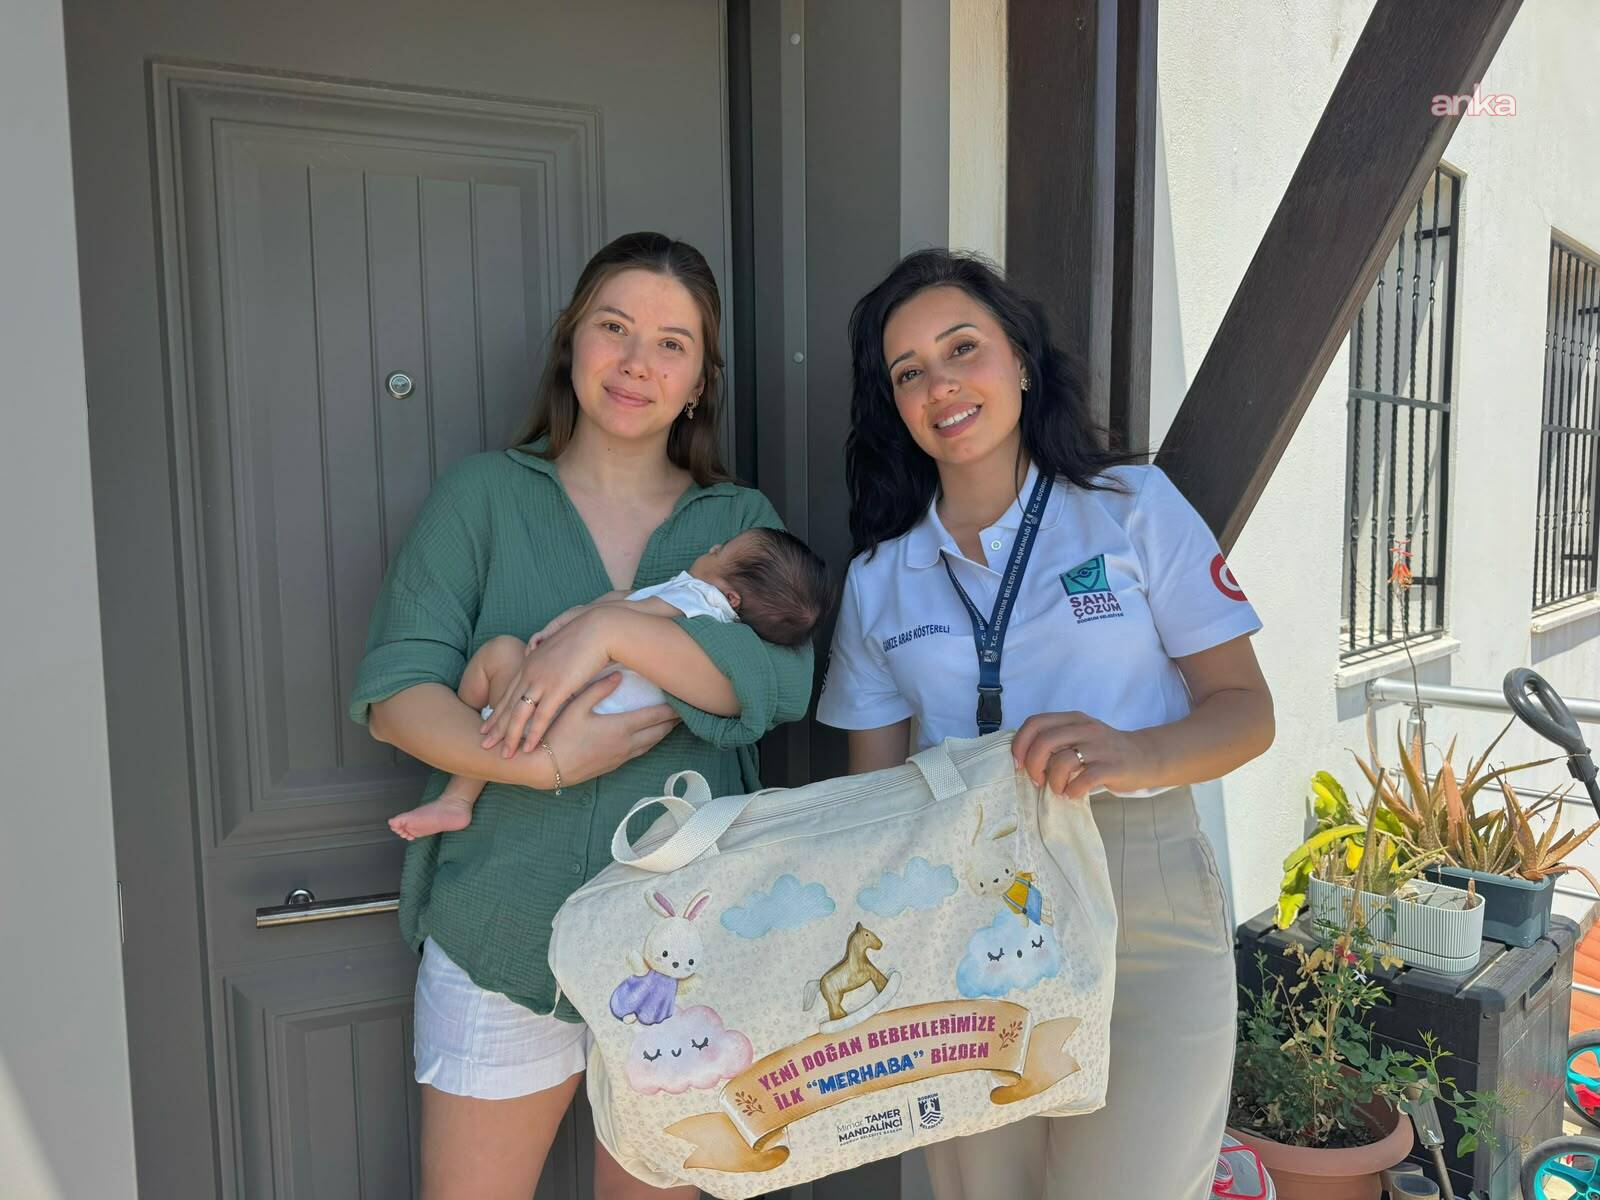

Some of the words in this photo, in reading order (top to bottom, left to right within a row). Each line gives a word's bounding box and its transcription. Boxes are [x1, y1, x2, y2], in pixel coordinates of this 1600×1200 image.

[1069, 592, 1118, 608] SAHA
[994, 599, 1009, 631] BODRUM
[898, 630, 912, 646] ARAS
[758, 1059, 800, 1092] YENİ
[801, 1036, 863, 1073] DOĞAN
[867, 1012, 996, 1049] BEBEKLERİMİZE
[774, 1086, 805, 1112] İLK
[930, 1042, 989, 1065] BİZDEN
[836, 1120, 863, 1134] Mimar
[864, 1108, 901, 1123] TAMER
[838, 1116, 903, 1143] MANDALİNCİ
